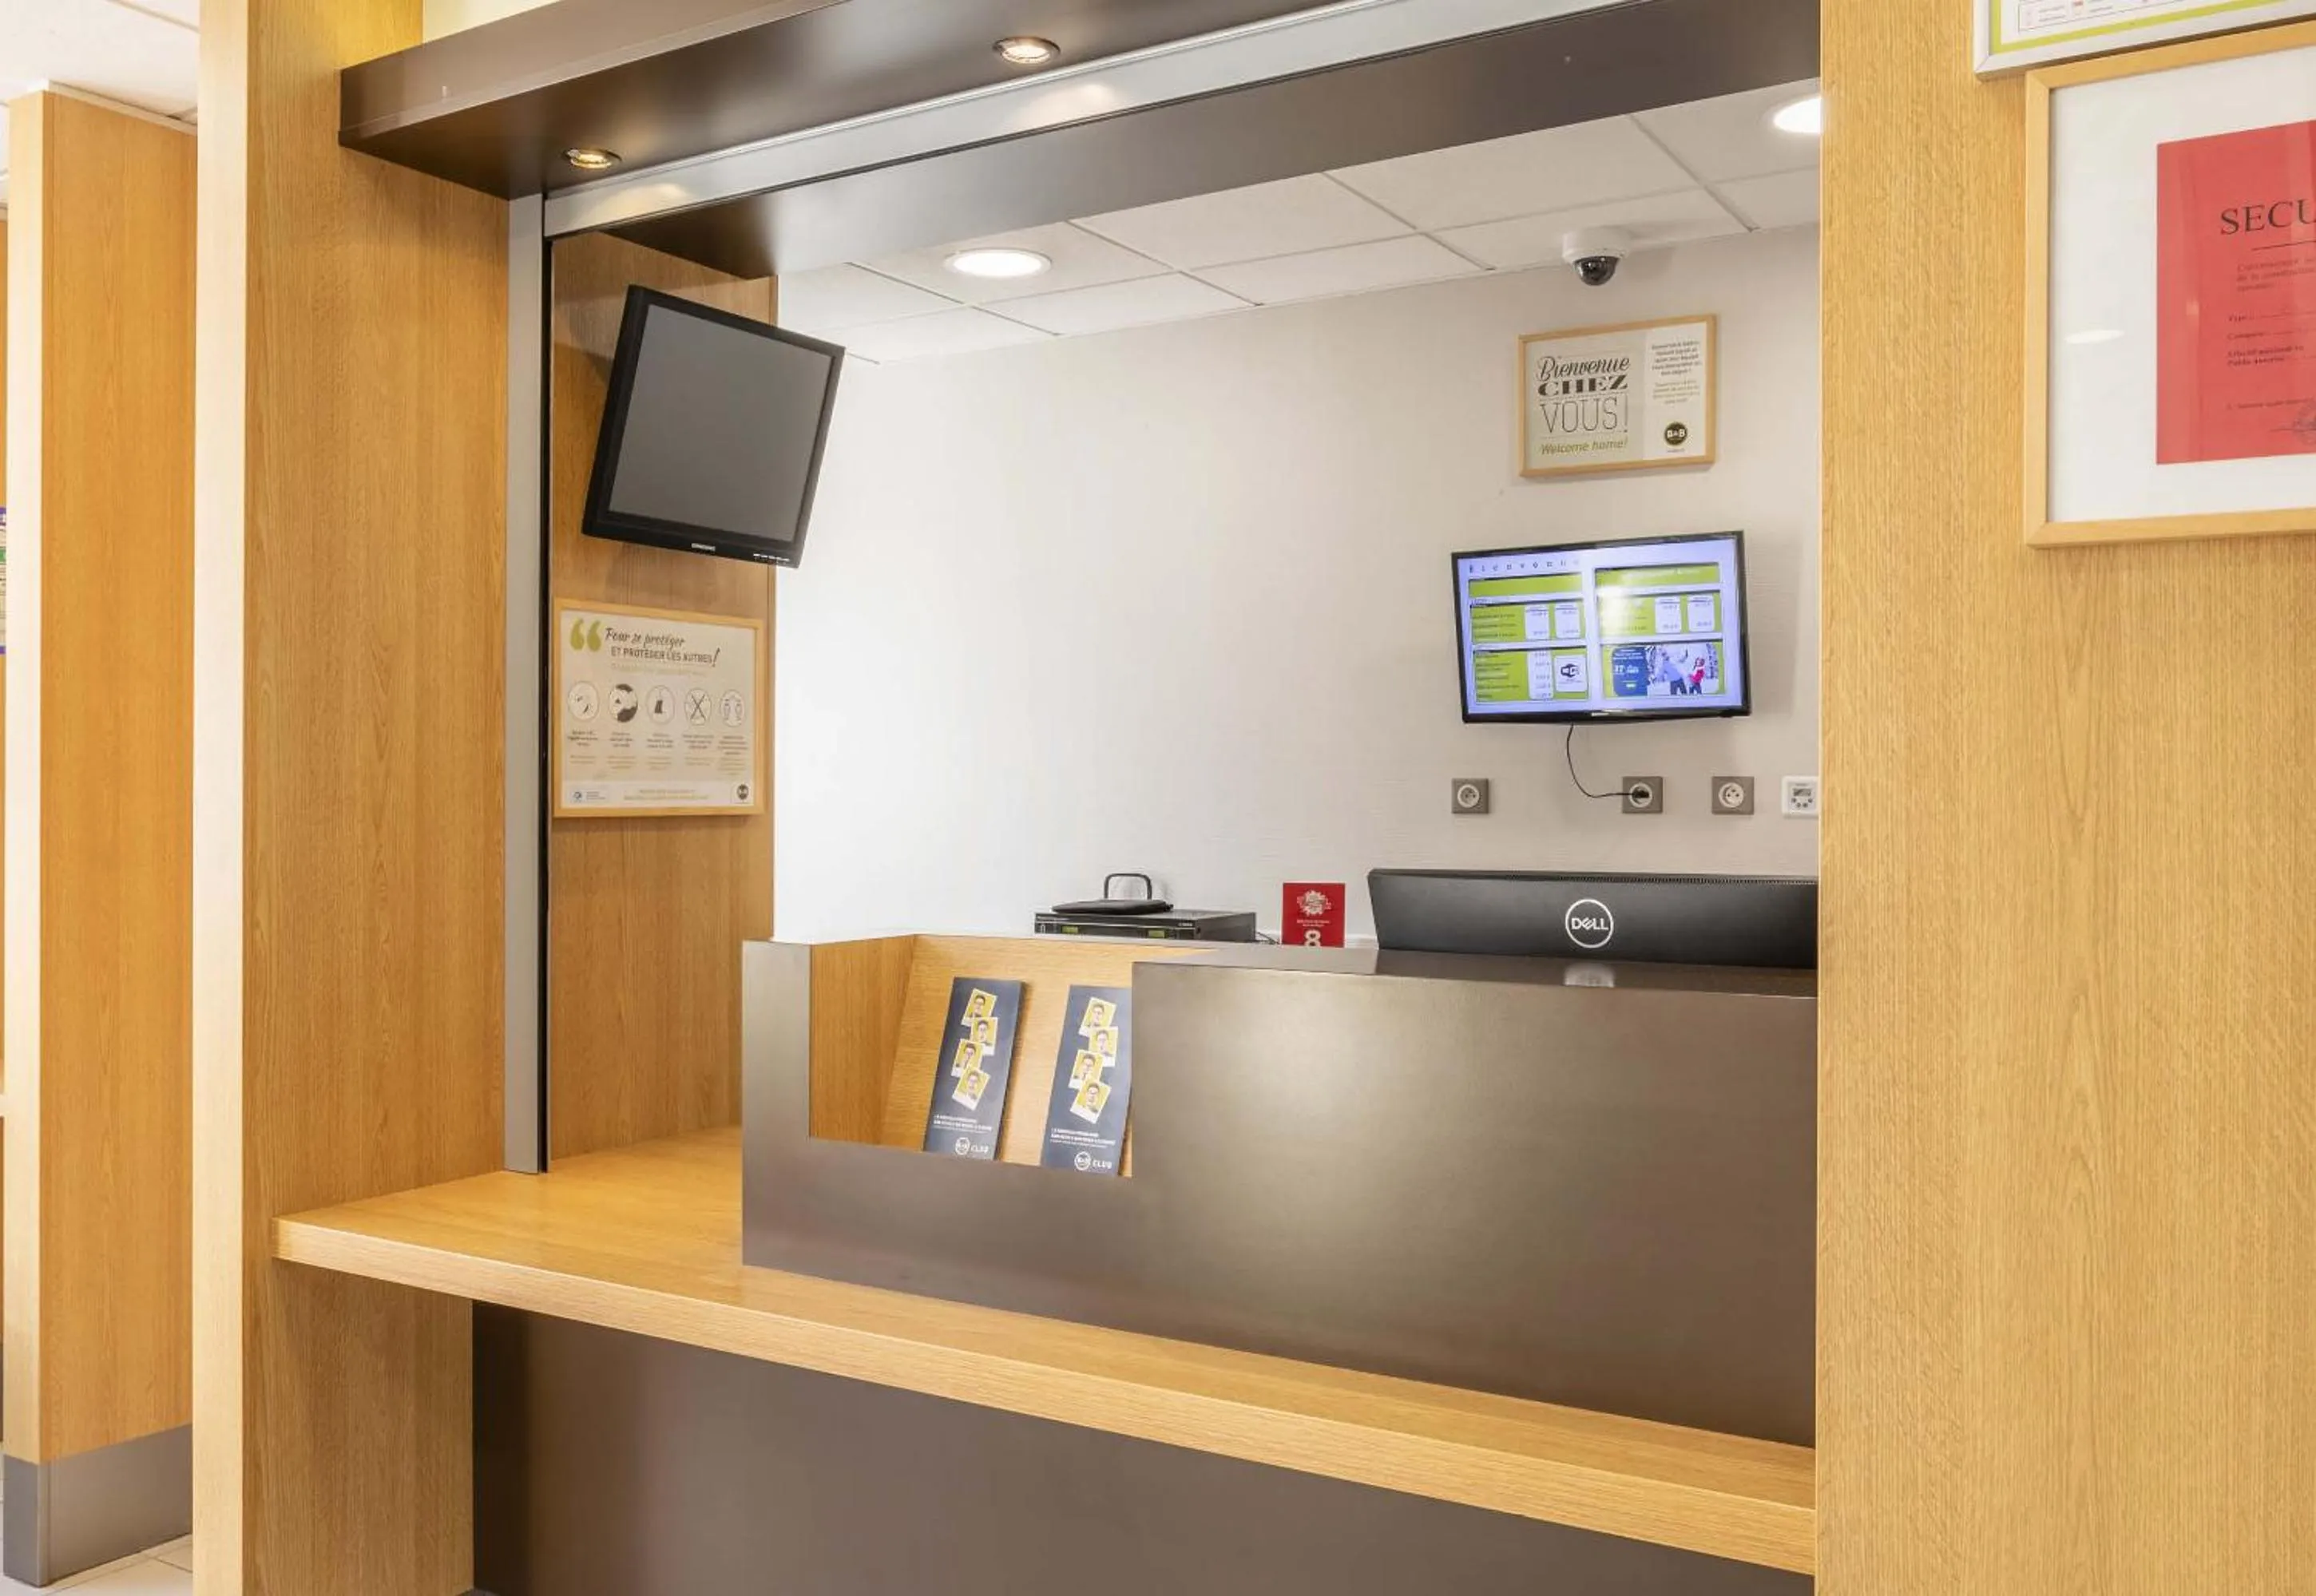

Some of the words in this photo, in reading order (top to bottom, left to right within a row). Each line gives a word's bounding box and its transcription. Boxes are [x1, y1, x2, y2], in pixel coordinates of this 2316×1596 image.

[1537, 355, 1630, 382] Bienvenue
[1537, 374, 1628, 396] CHEZ
[1541, 442, 1588, 454] Welcome
[666, 651, 681, 661] LES
[1571, 917, 1608, 930] DELL
[1304, 929, 1321, 947] 8
